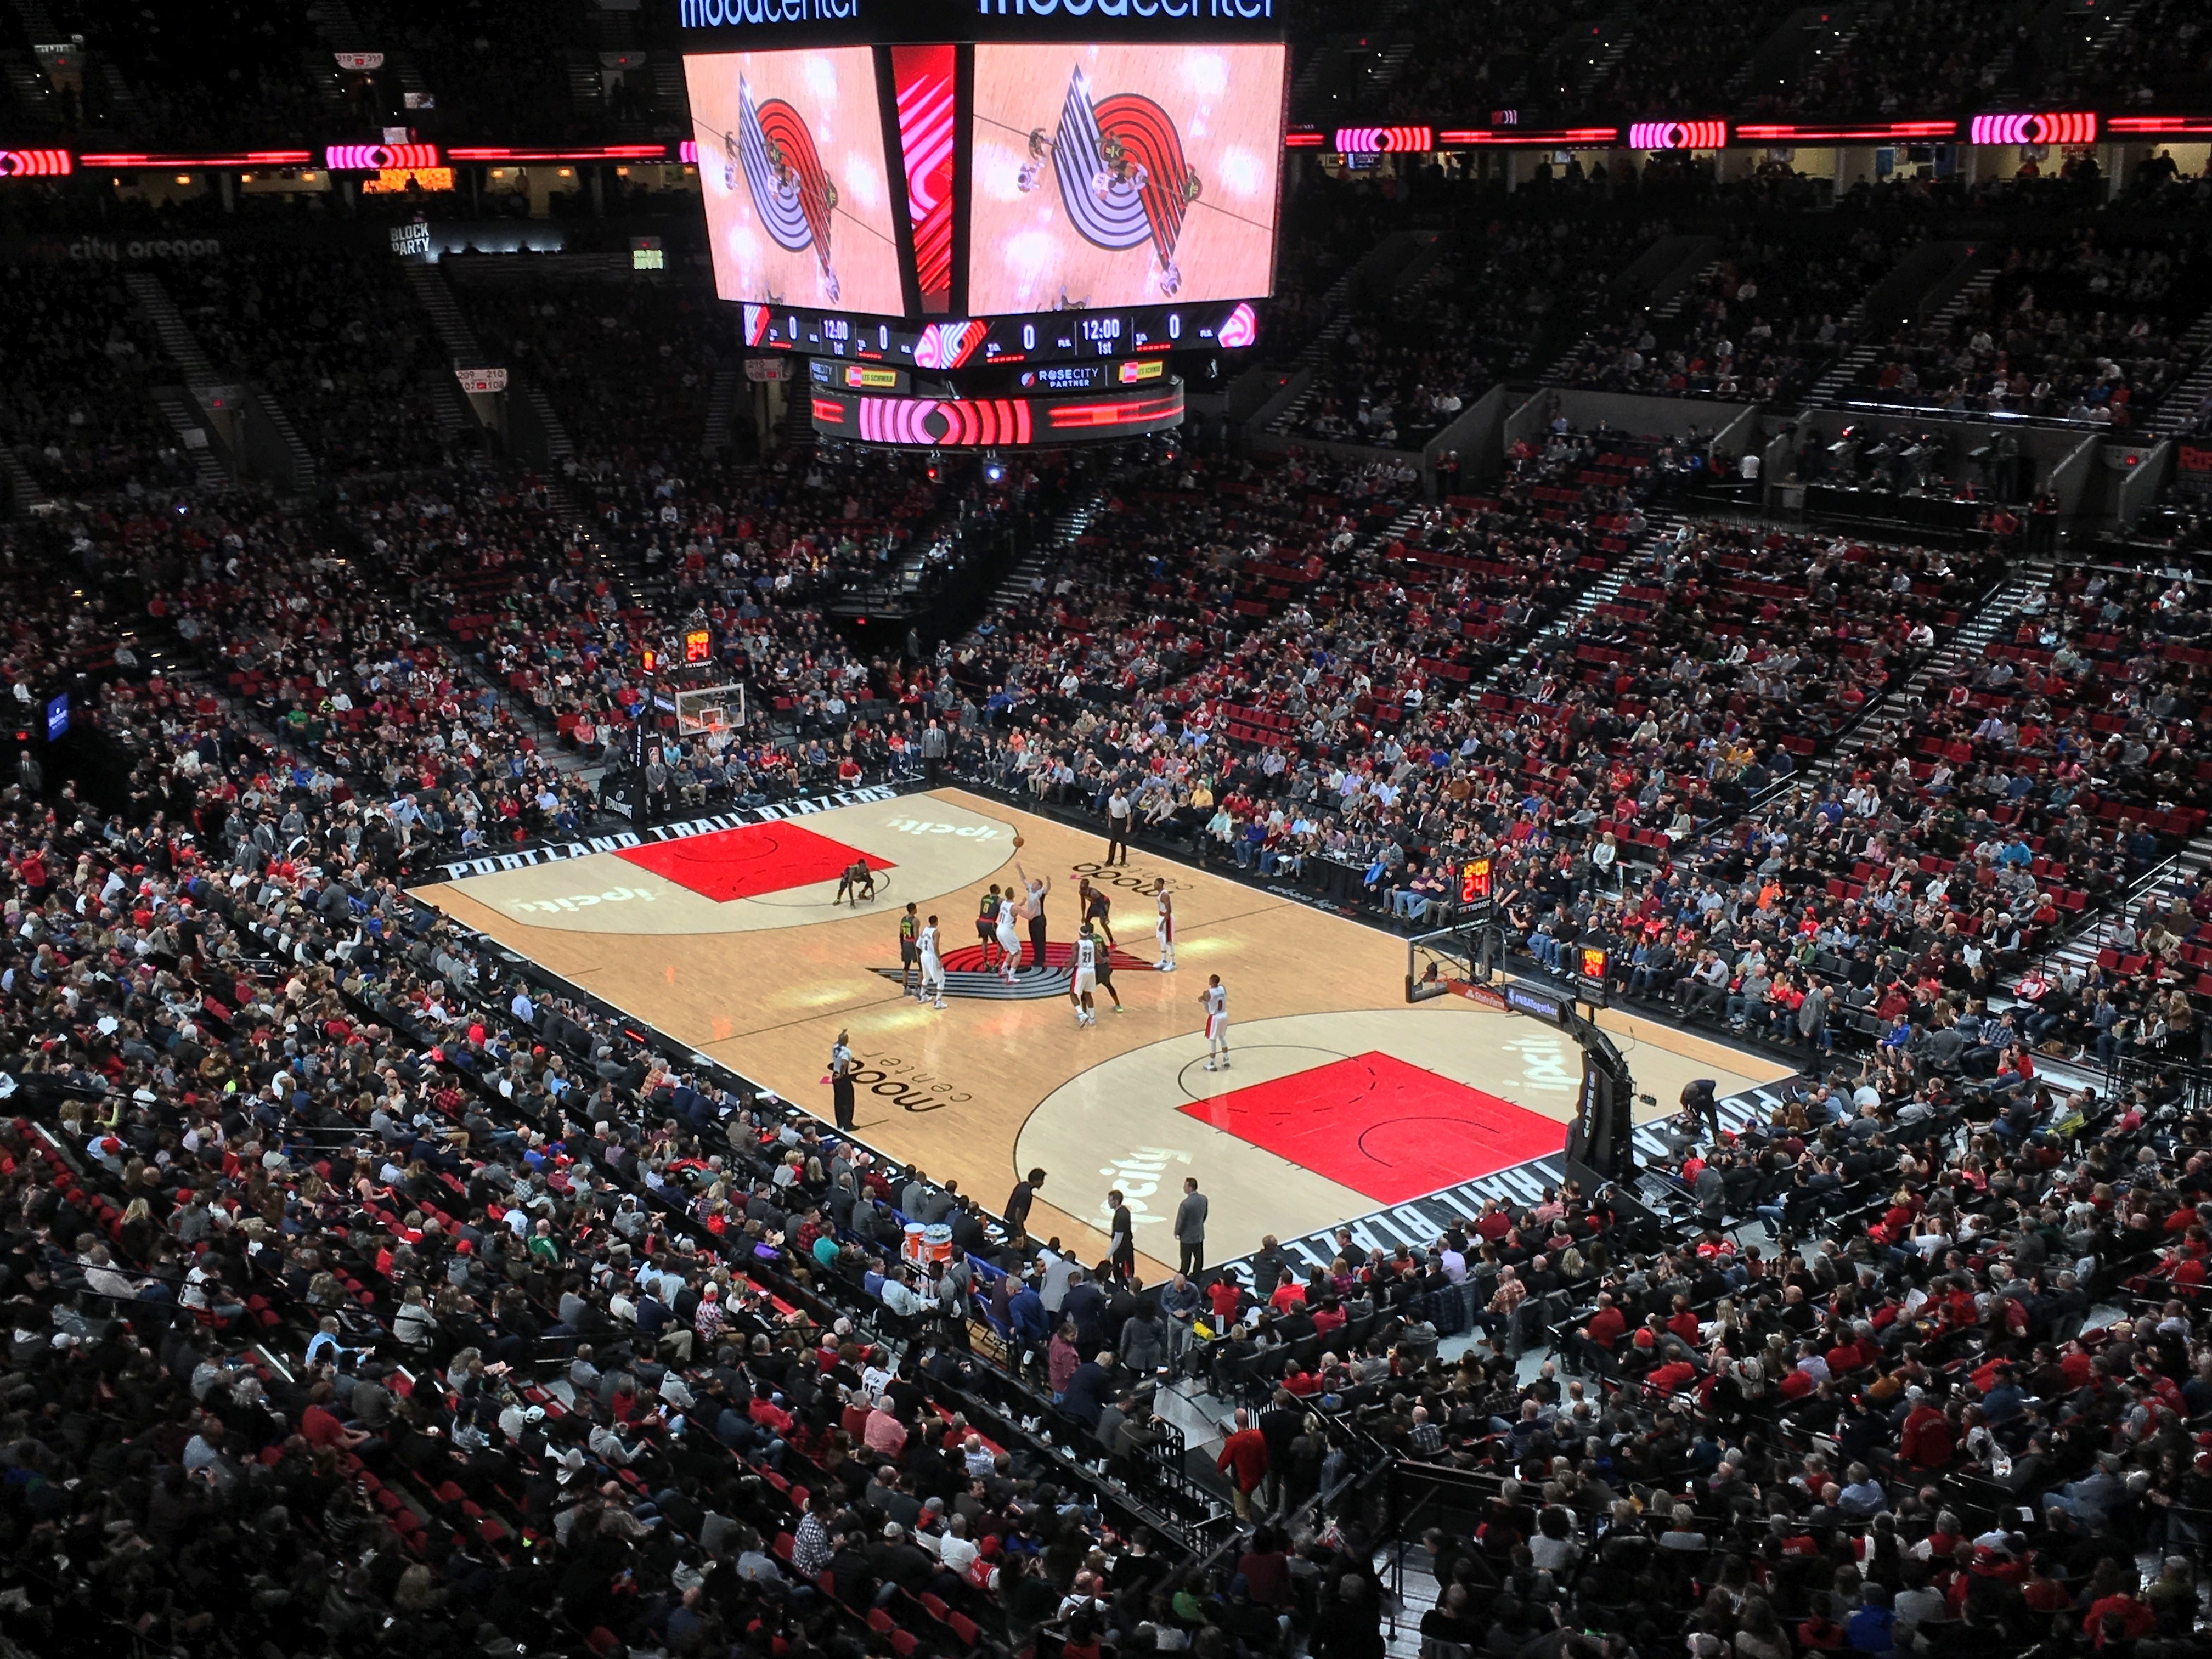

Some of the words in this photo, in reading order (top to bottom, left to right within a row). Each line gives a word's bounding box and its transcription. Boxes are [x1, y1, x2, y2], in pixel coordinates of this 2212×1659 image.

[391, 222, 429, 241] BLOCK
[127, 239, 221, 260] oregon
[392, 237, 430, 256] PARTY
[789, 315, 797, 340] 0
[824, 320, 849, 340] 12:00
[1082, 319, 1120, 341] 12:00
[1169, 314, 1180, 339] 0
[879, 325, 888, 351] 0
[1023, 323, 1035, 350] 0
[833, 342, 844, 356] 1st
[1097, 341, 1112, 355] 1st
[459, 371, 475, 379] 209
[1050, 379, 1090, 388] PARTNER
[687, 632, 709, 645] 12:00
[687, 644, 707, 661] 24
[605, 795, 633, 819] SPALDING
[447, 832, 642, 878] PORTLAND
[648, 811, 752, 841] TRAIL
[751, 784, 900, 822] BLAZERS
[1464, 860, 1488, 878] 12:00
[1463, 876, 1486, 902] 24
[504, 886, 665, 914] ipcity
[924, 939, 928, 951] 1
[1082, 951, 1091, 963] 21
[1584, 950, 1603, 966] 12:00
[1584, 961, 1599, 977] 24
[1475, 991, 1489, 1005] State
[1489, 996, 1504, 1009] Farm
[1515, 994, 1558, 1017] #NBATogether
[861, 1052, 972, 1103] center
[1585, 1088, 1595, 1118] NBA
[1583, 1119, 1591, 1138] TV
